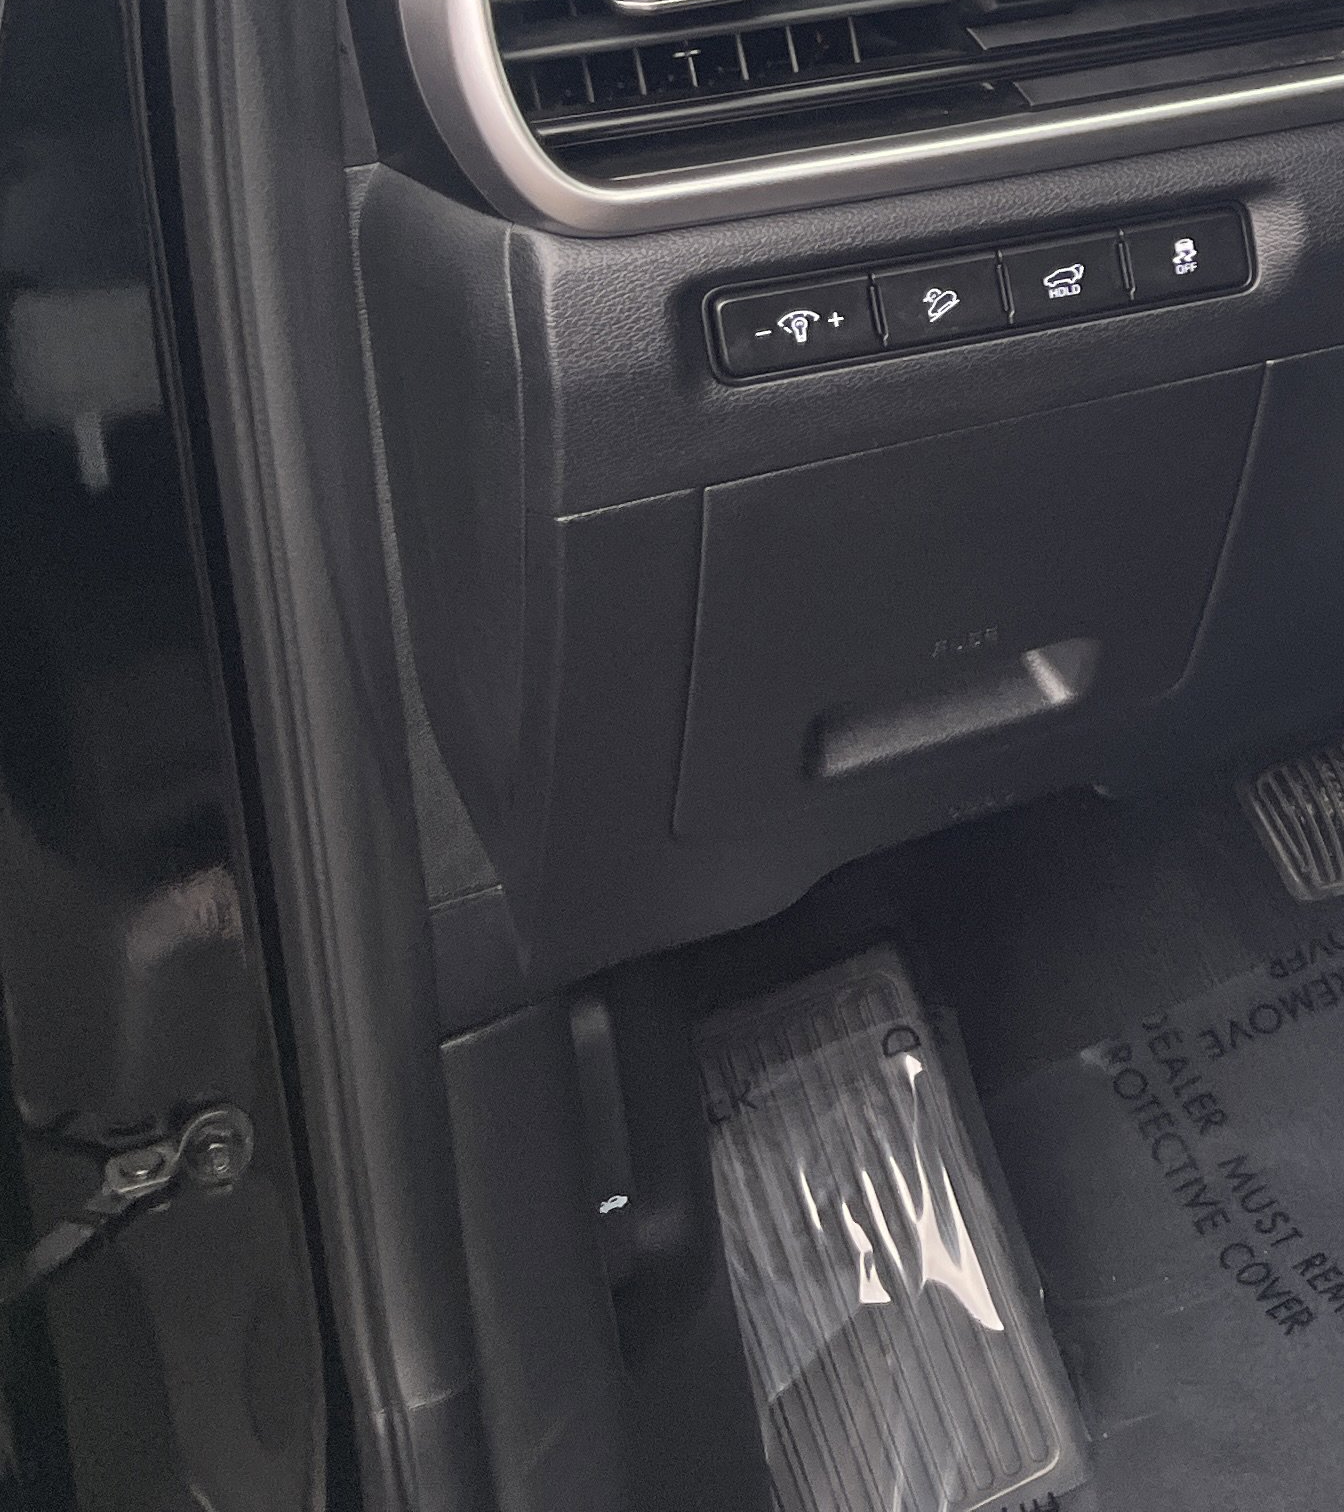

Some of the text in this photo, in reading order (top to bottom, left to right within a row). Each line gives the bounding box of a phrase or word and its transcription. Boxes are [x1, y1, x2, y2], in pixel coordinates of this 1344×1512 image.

[1048, 284, 1081, 299] HOLD
[1174, 261, 1198, 275] OFF
[1218, 1153, 1303, 1248] MUST
[1219, 1242, 1315, 1336] COVER
